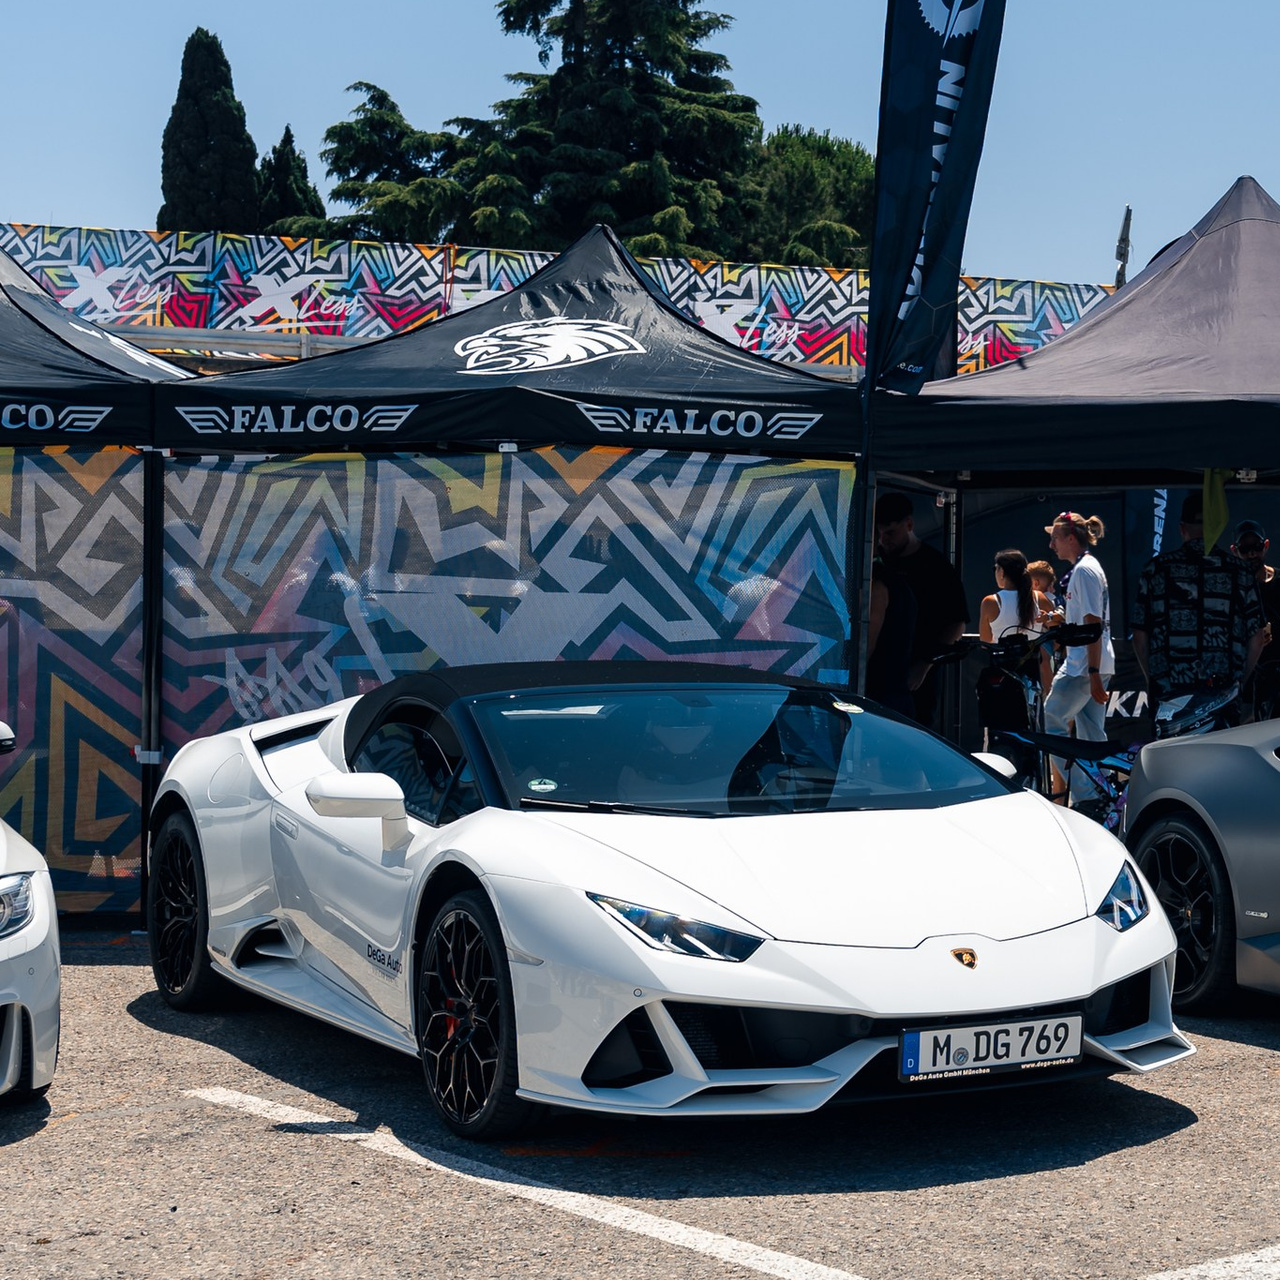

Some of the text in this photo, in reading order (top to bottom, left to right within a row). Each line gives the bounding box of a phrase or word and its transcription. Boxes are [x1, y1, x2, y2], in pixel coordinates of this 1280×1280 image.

[112, 269, 178, 311] Less
[298, 279, 364, 318] Less
[741, 306, 807, 348] Less
[231, 405, 359, 434] FALCO
[632, 408, 764, 437] FALCO
[367, 943, 403, 975] DeGa Auto
[932, 1022, 1069, 1067] M DG 769
[907, 1058, 914, 1068] D
